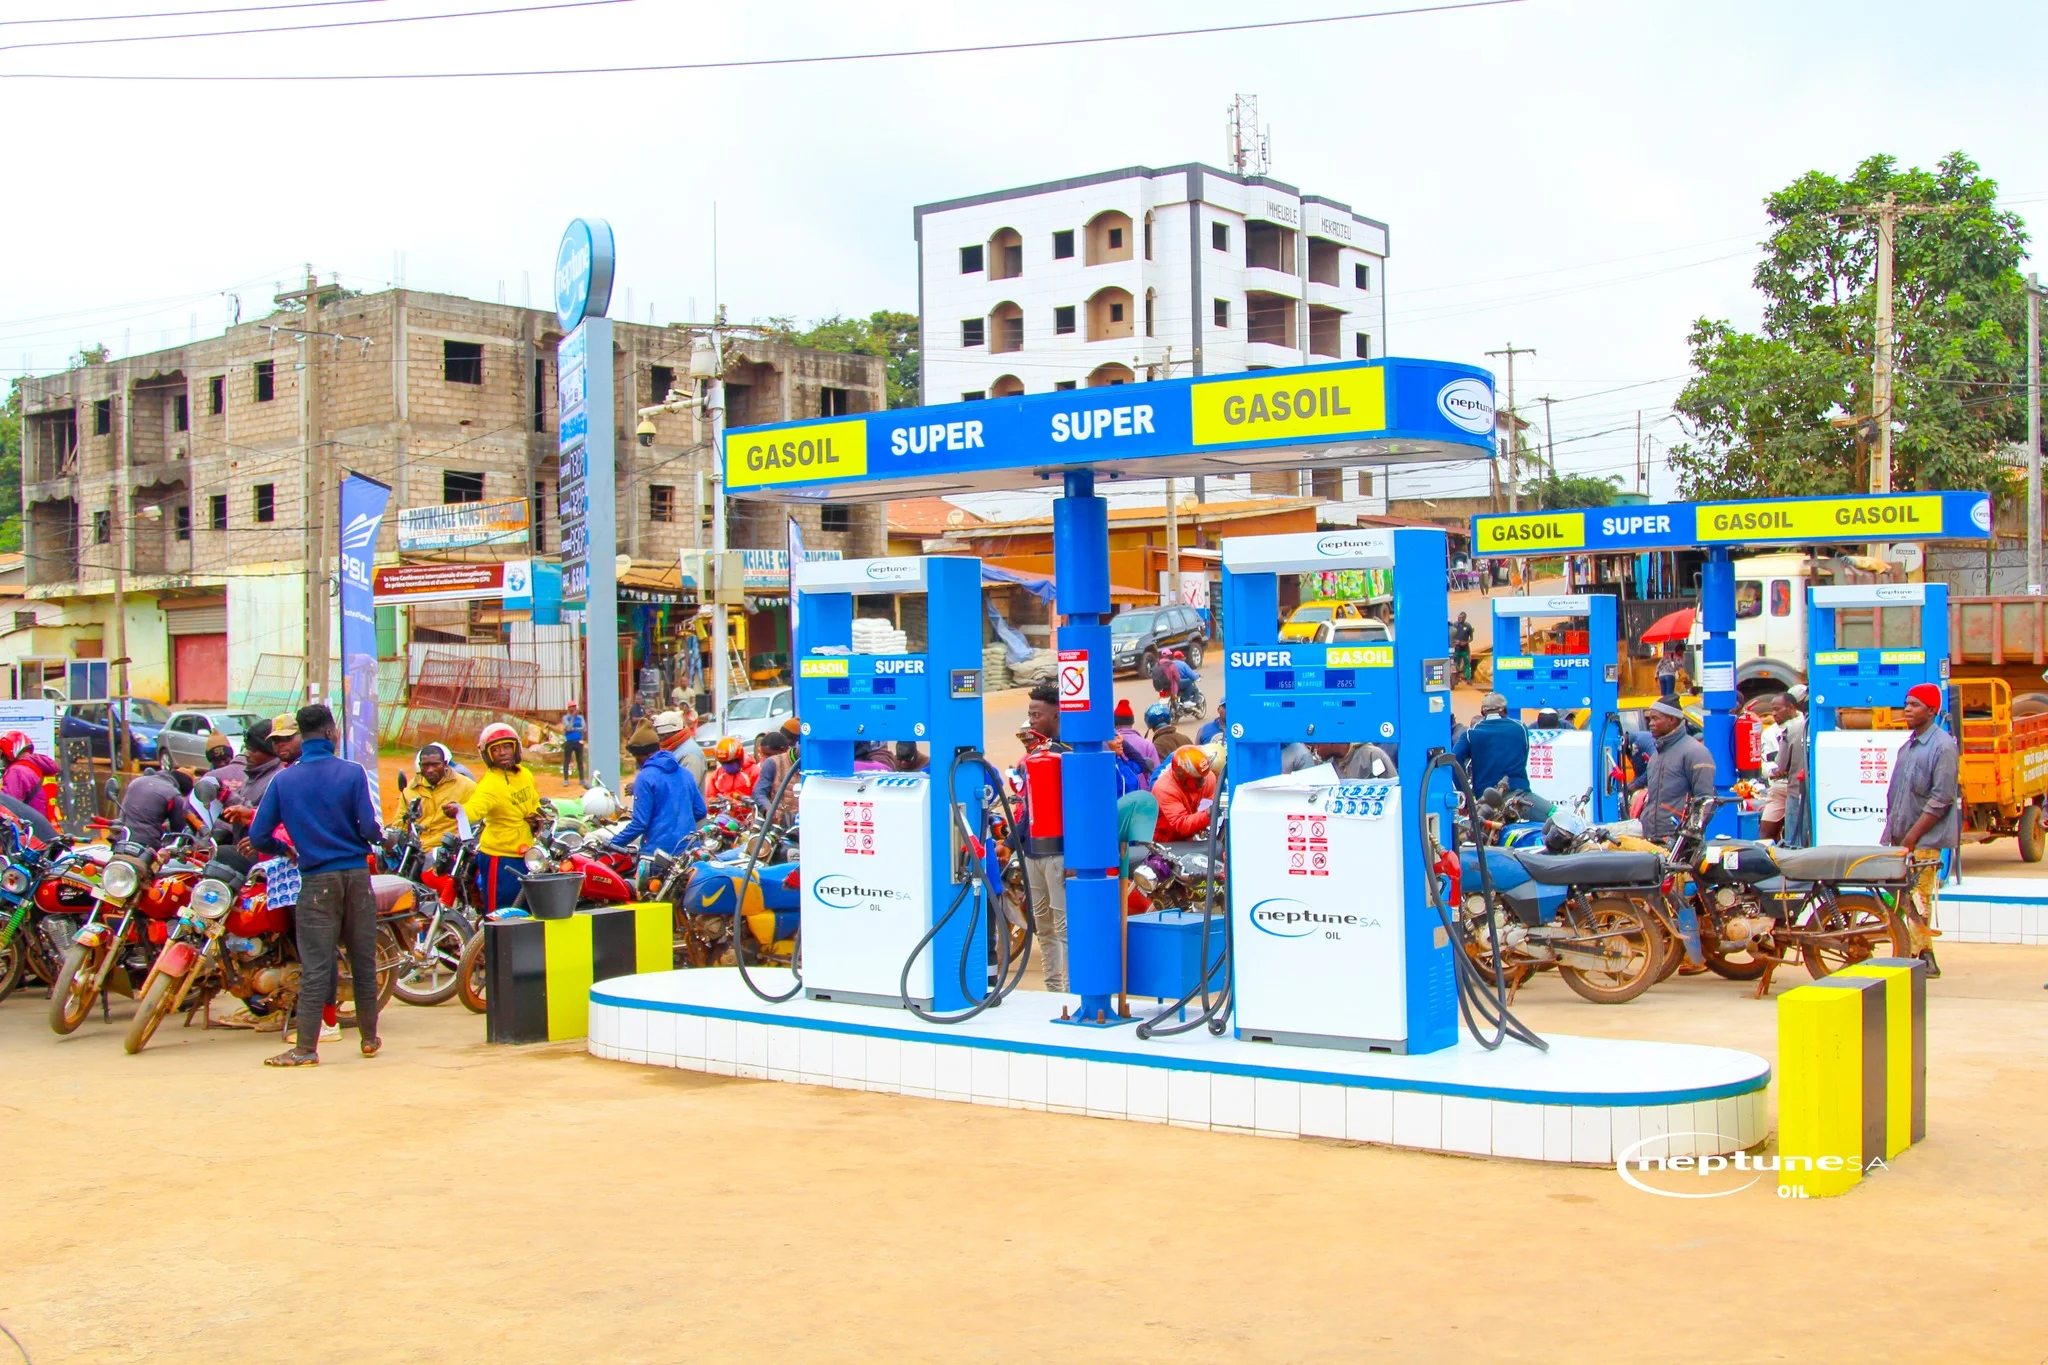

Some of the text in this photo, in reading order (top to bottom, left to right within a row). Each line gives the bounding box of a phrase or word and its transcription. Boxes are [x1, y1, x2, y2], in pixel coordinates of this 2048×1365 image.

[1223, 385, 1351, 426] GASOIL
[891, 404, 1155, 456] SUPER SUPER
[747, 438, 840, 472] GASOIL
[1491, 515, 1671, 542] GASOIL SUPER
[1713, 505, 1920, 531] GASOIL GASOIL
[801, 660, 924, 675] GASOIL SUPER
[1230, 651, 1393, 668] SUPER GASOIL
[1553, 658, 1590, 668] SUPER
[869, 903, 882, 911] OIL
[1325, 931, 1341, 940] OIL
